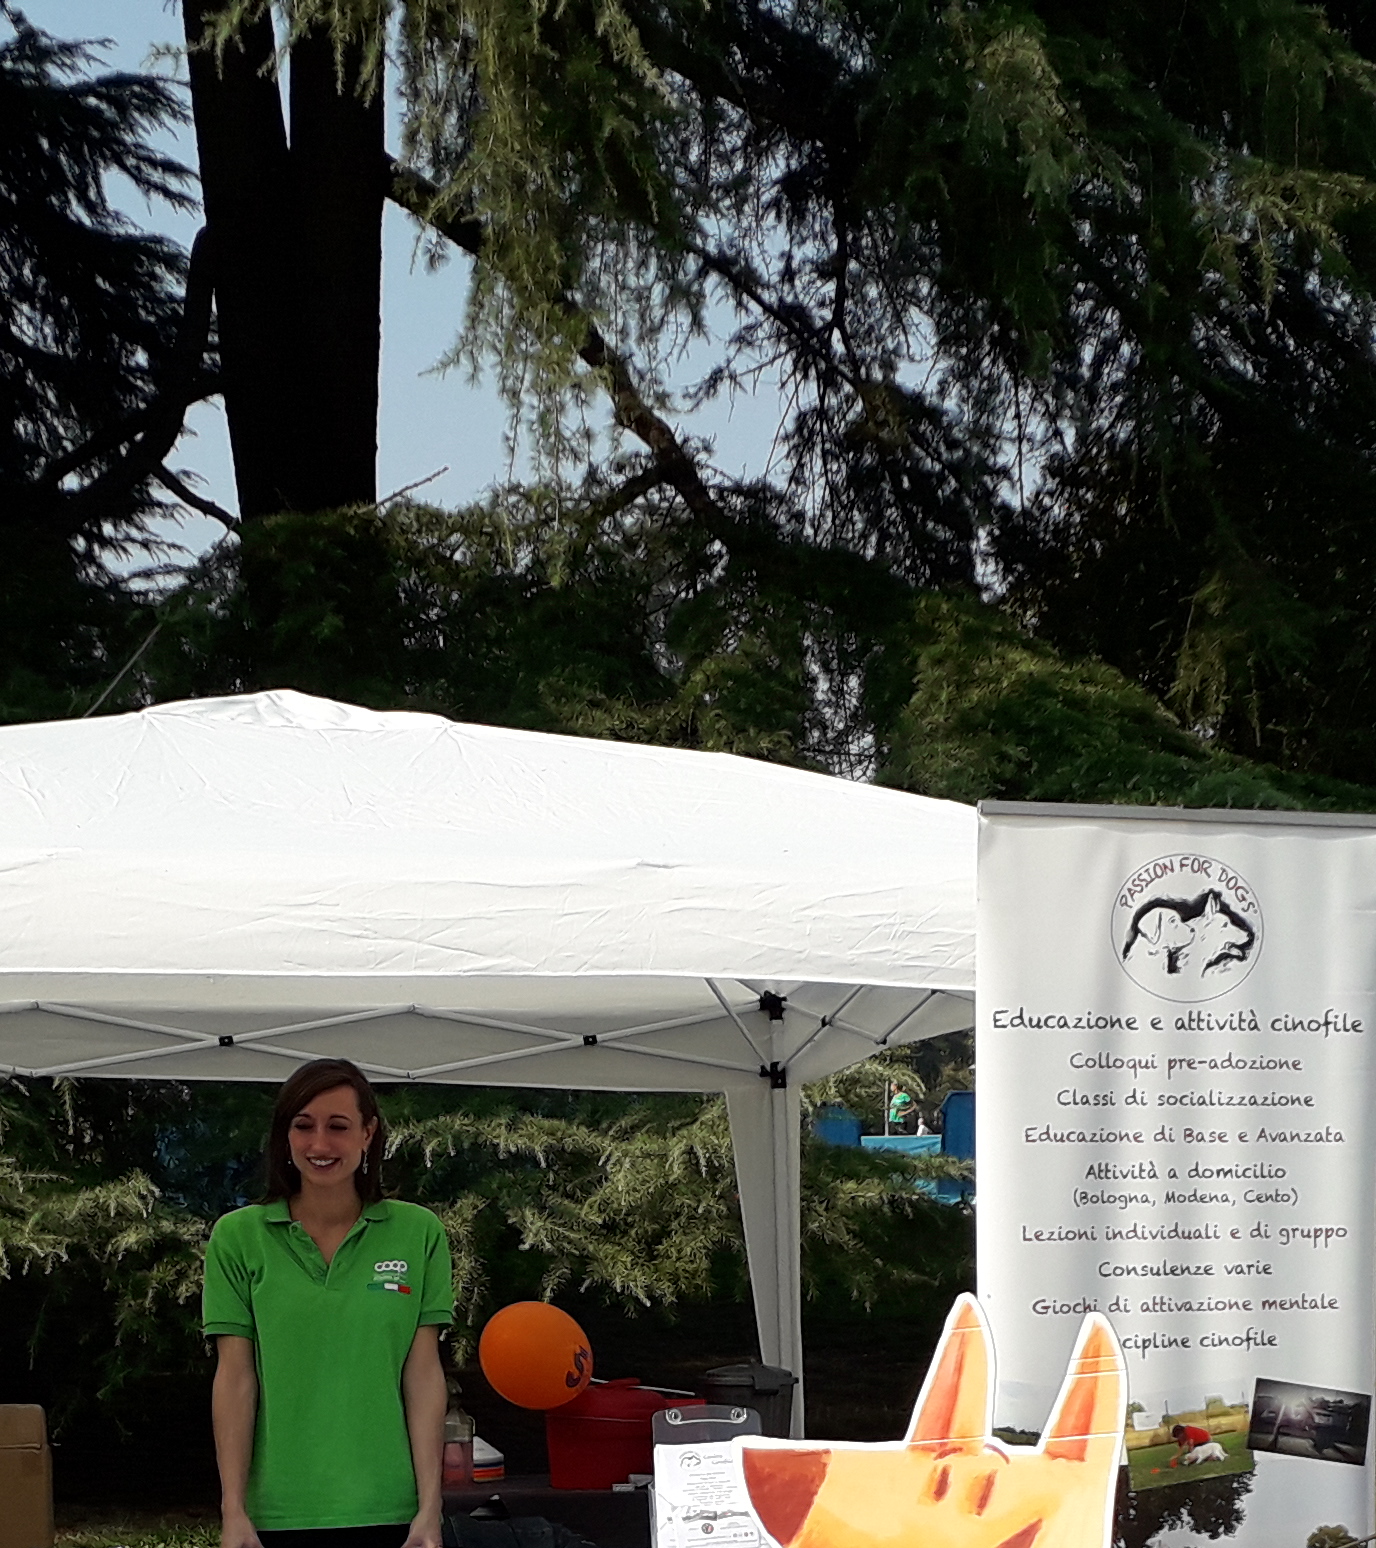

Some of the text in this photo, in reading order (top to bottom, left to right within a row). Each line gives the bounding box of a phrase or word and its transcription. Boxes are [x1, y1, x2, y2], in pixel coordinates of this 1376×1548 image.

[1119, 857, 1256, 913] PASSION FOR DOGS
[992, 1007, 1365, 1038] Educazione e attività cinofile
[1070, 1052, 1304, 1080] Colloqui pre-adozione
[1057, 1088, 1315, 1108] Classi di socializzazione
[1024, 1125, 1346, 1145] Educazione di Base e Avanzata
[1085, 1161, 1287, 1181] Attività a domicilio
[1073, 1187, 1298, 1210] (Bologna, Modena, Cento)
[1022, 1221, 1348, 1249] Lezioni individuali e di gruppo
[1098, 1259, 1273, 1278] Consulenze varie
[1032, 1292, 1340, 1315] Giochi di attivazione mentale
[1121, 1326, 1278, 1358] cipline cinofile
